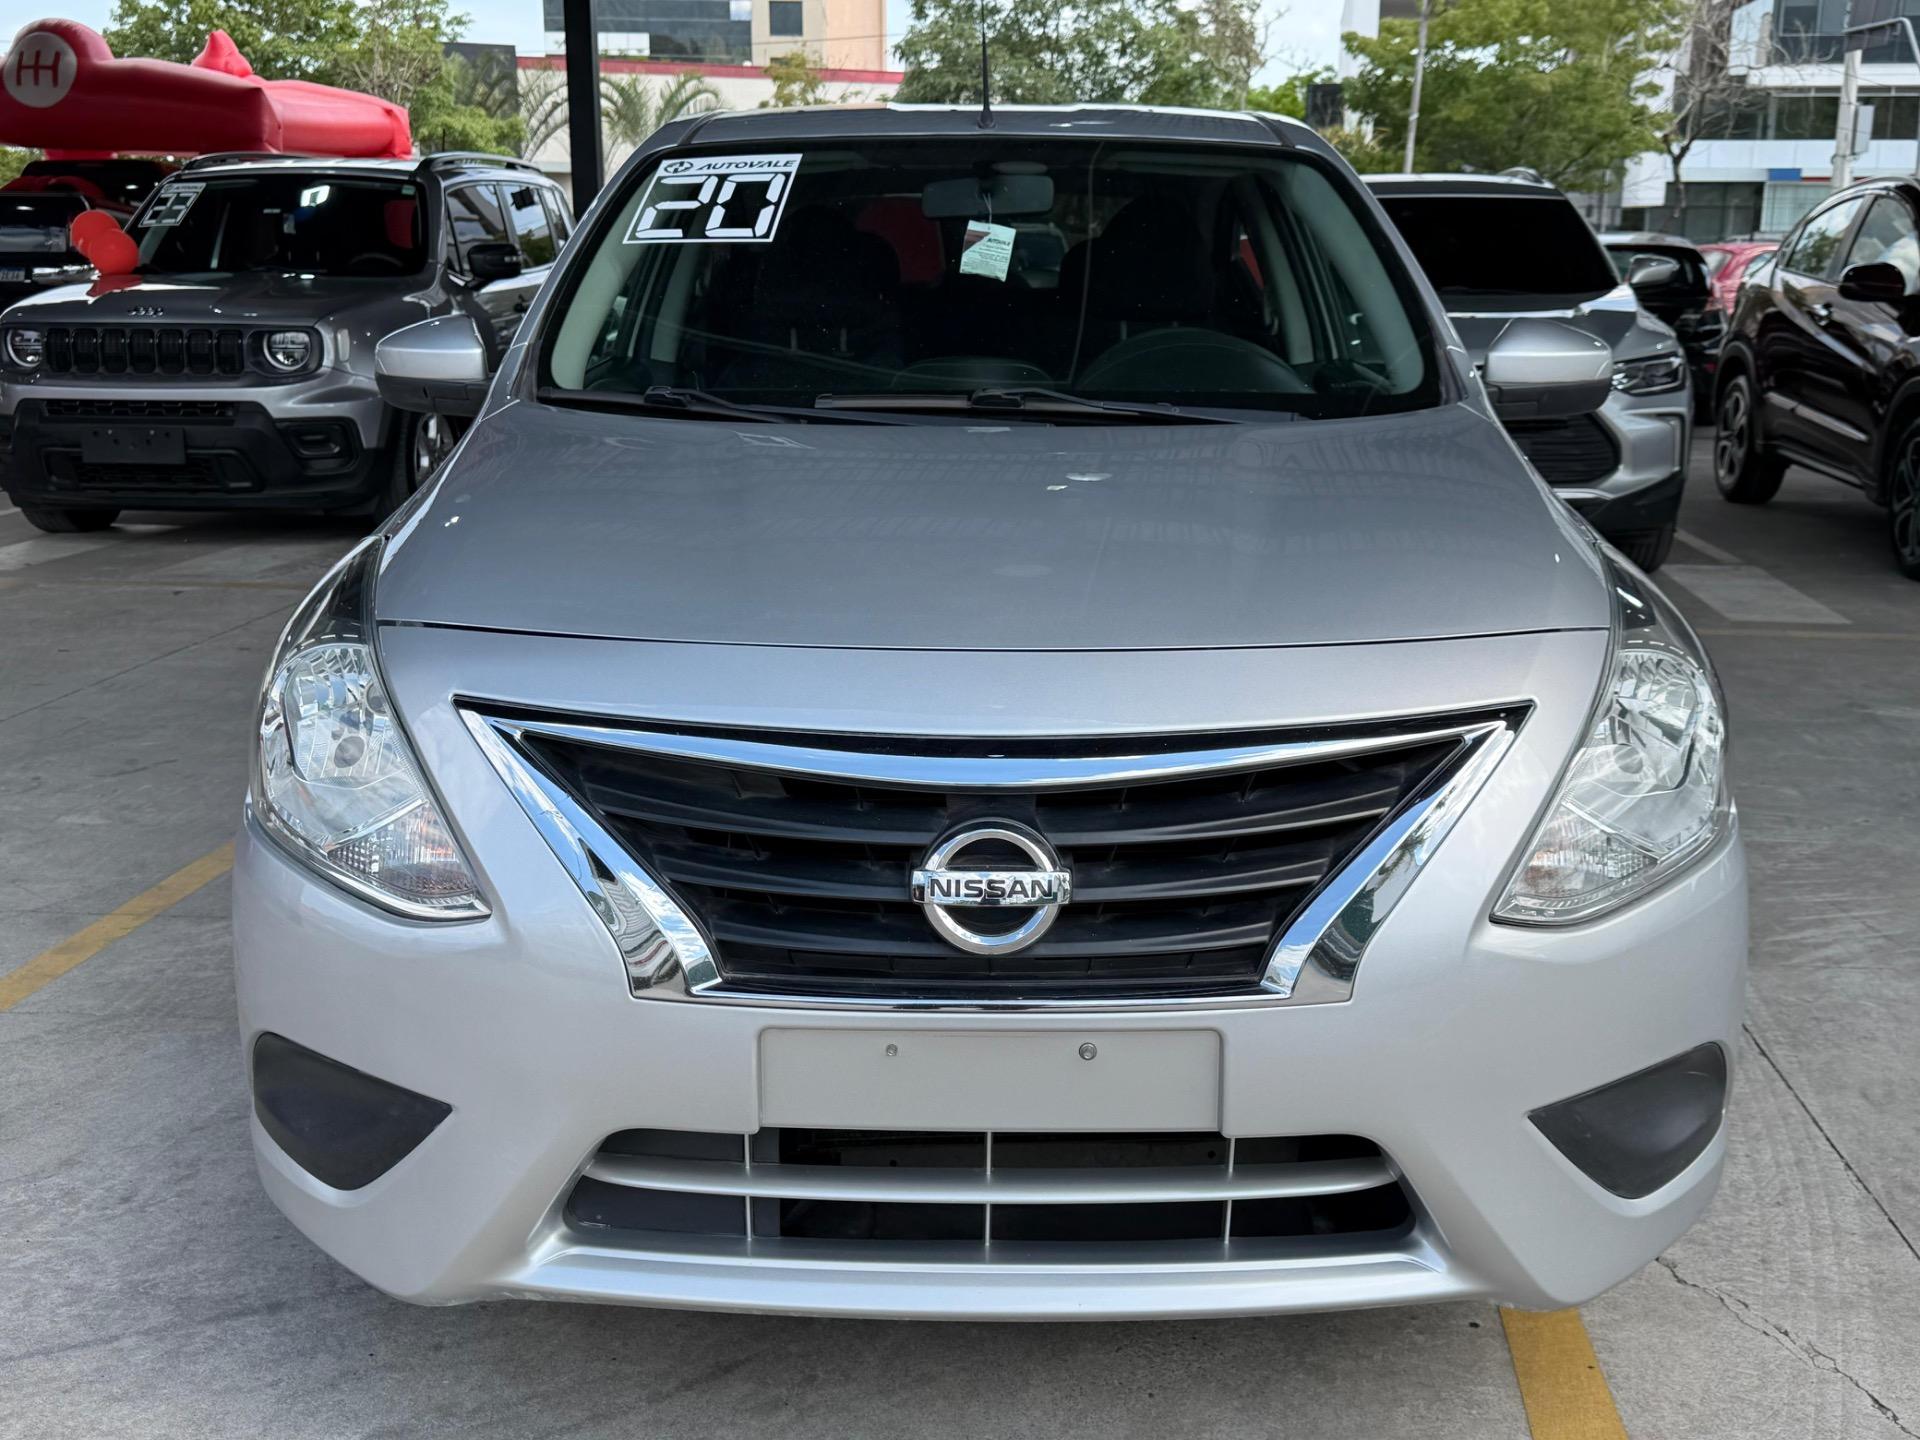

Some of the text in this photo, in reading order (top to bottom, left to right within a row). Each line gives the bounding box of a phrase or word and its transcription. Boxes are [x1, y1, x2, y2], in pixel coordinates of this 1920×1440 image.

[696, 159, 797, 171] AUTOVALE
[142, 192, 198, 224] 23
[635, 173, 786, 239] 20
[929, 878, 1054, 899] NISSAN
